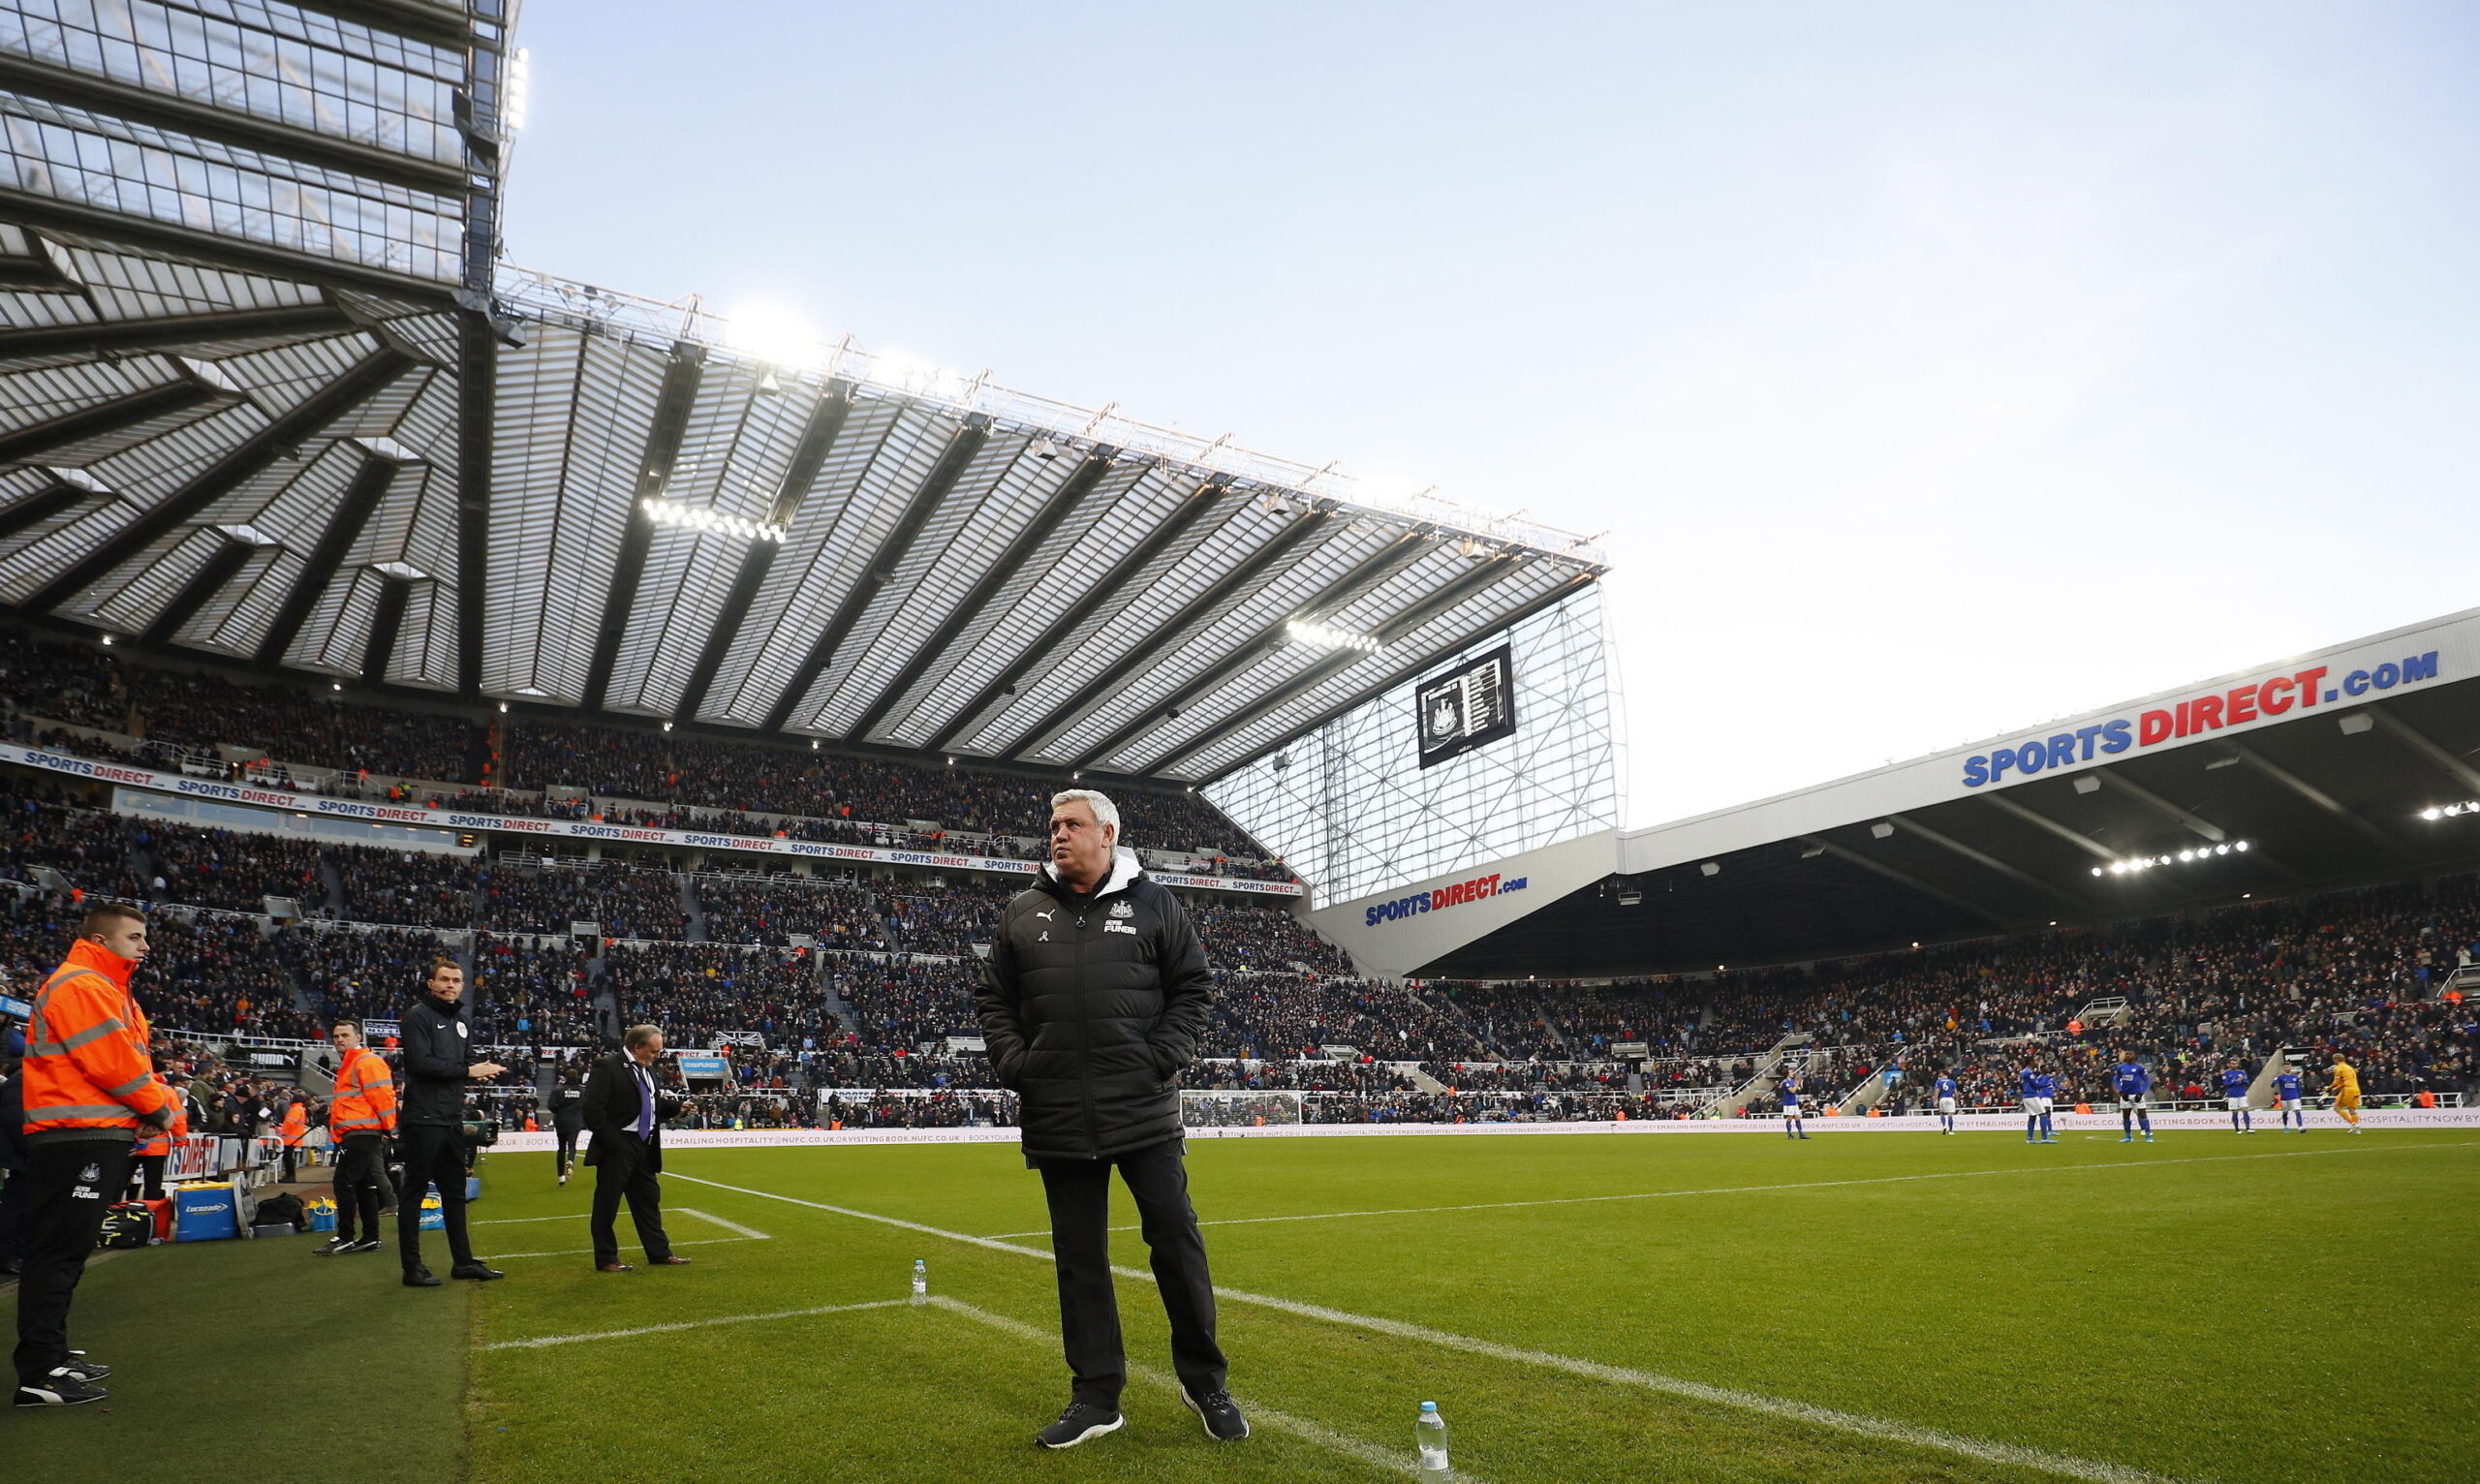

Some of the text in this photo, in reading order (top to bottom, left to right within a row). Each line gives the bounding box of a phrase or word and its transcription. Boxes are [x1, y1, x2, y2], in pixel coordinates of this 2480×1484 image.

[1962, 650, 2439, 788] SPORTSDIRECT.COM
[1365, 873, 1528, 927] SPORTSDIRECT.COM
[250, 1053, 284, 1066] PUMA
[1942, 1081, 1949, 1092] 6
[2303, 1116, 2326, 1125] OOK
[2358, 1114, 2431, 1124] HOSPITALITY
[2433, 1114, 2464, 1123] NOW
[526, 1137, 549, 1146] BOOK
[715, 1135, 834, 1145] HOSPITALITY@NUFC.CO.UK
[885, 1134, 960, 1143] BOOK.NUFC.CO.UK
